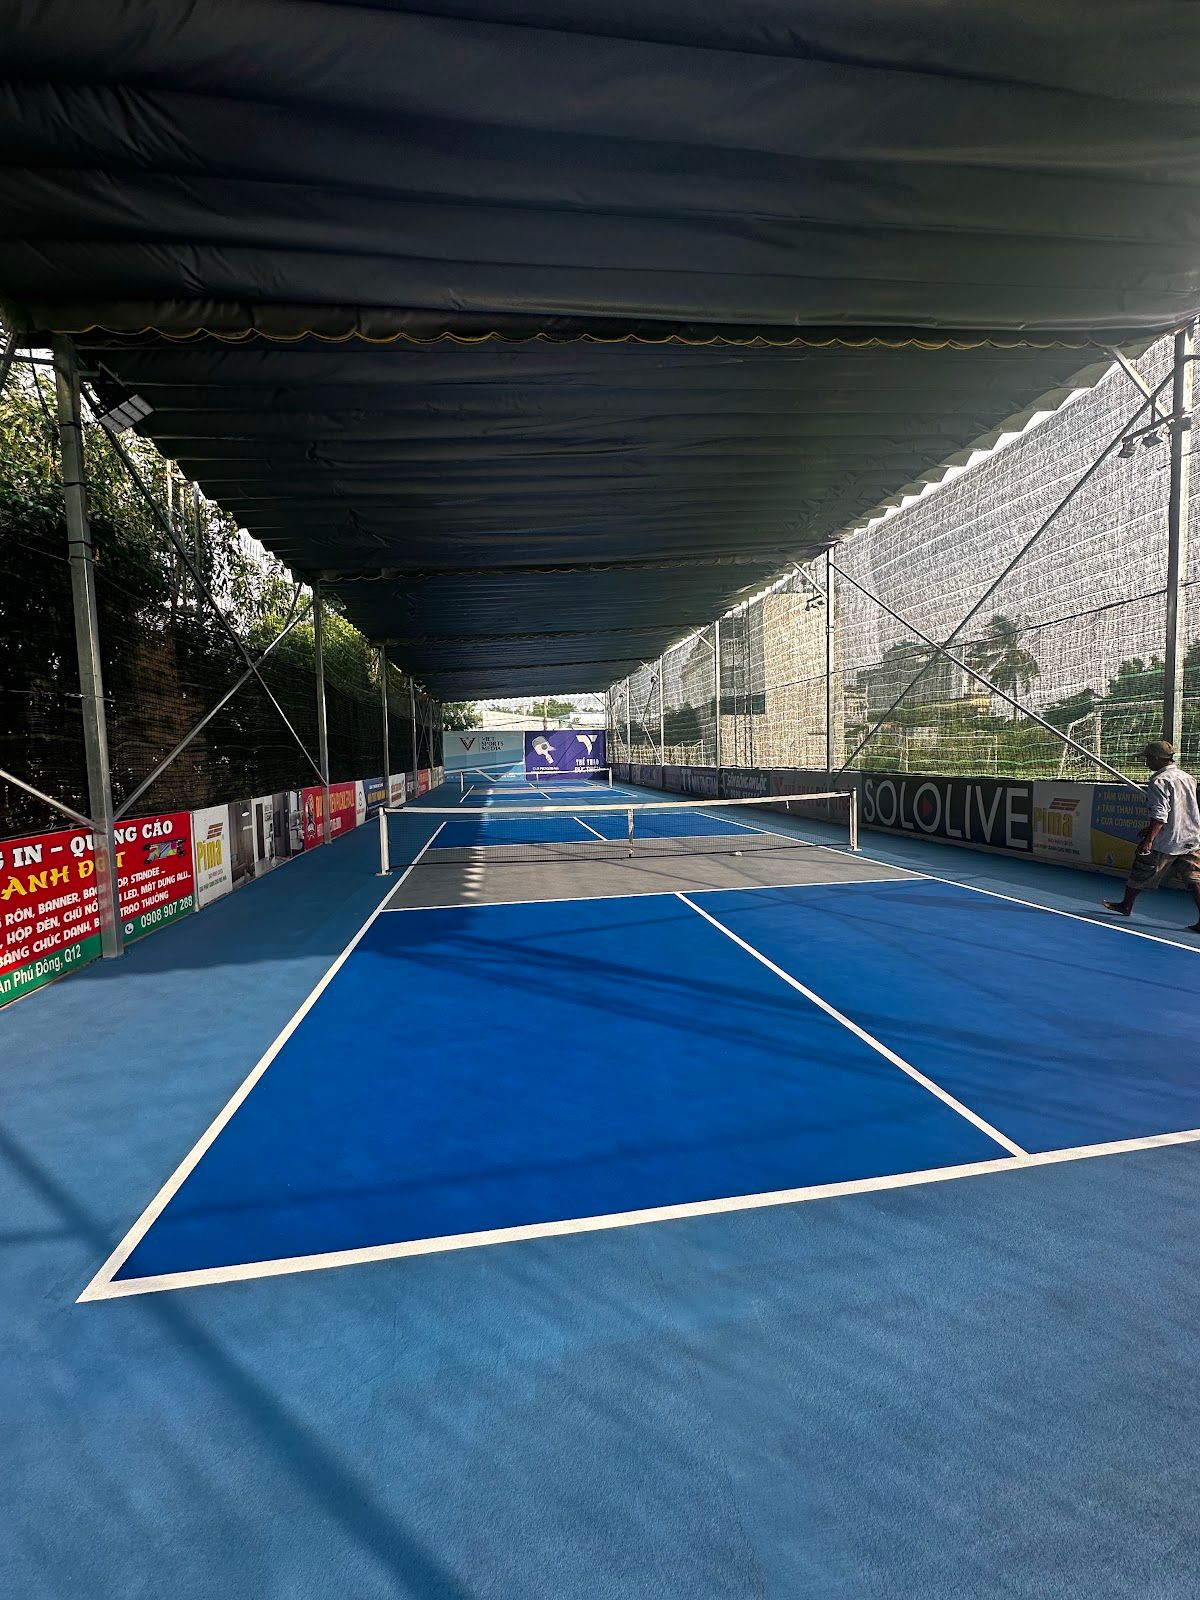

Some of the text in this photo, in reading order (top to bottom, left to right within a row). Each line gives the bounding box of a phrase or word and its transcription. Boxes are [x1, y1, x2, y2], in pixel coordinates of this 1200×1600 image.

[863, 779, 1029, 849] SOLOLIVE
[1033, 807, 1073, 837] Pima
[1114, 818, 1150, 829] COMPOSIT
[13, 844, 43, 868] IN
[142, 819, 173, 839] CÁO
[196, 840, 223, 874] Pima
[38, 892, 81, 915] BANNER,
[124, 888, 140, 902] LED,
[141, 895, 193, 928] 0908 907 288
[63, 920, 92, 941] DANH,
[120, 902, 140, 918] TRAO
[13, 966, 34, 988] Phú
[36, 958, 63, 978] Đông,
[64, 944, 82, 963] Q12
